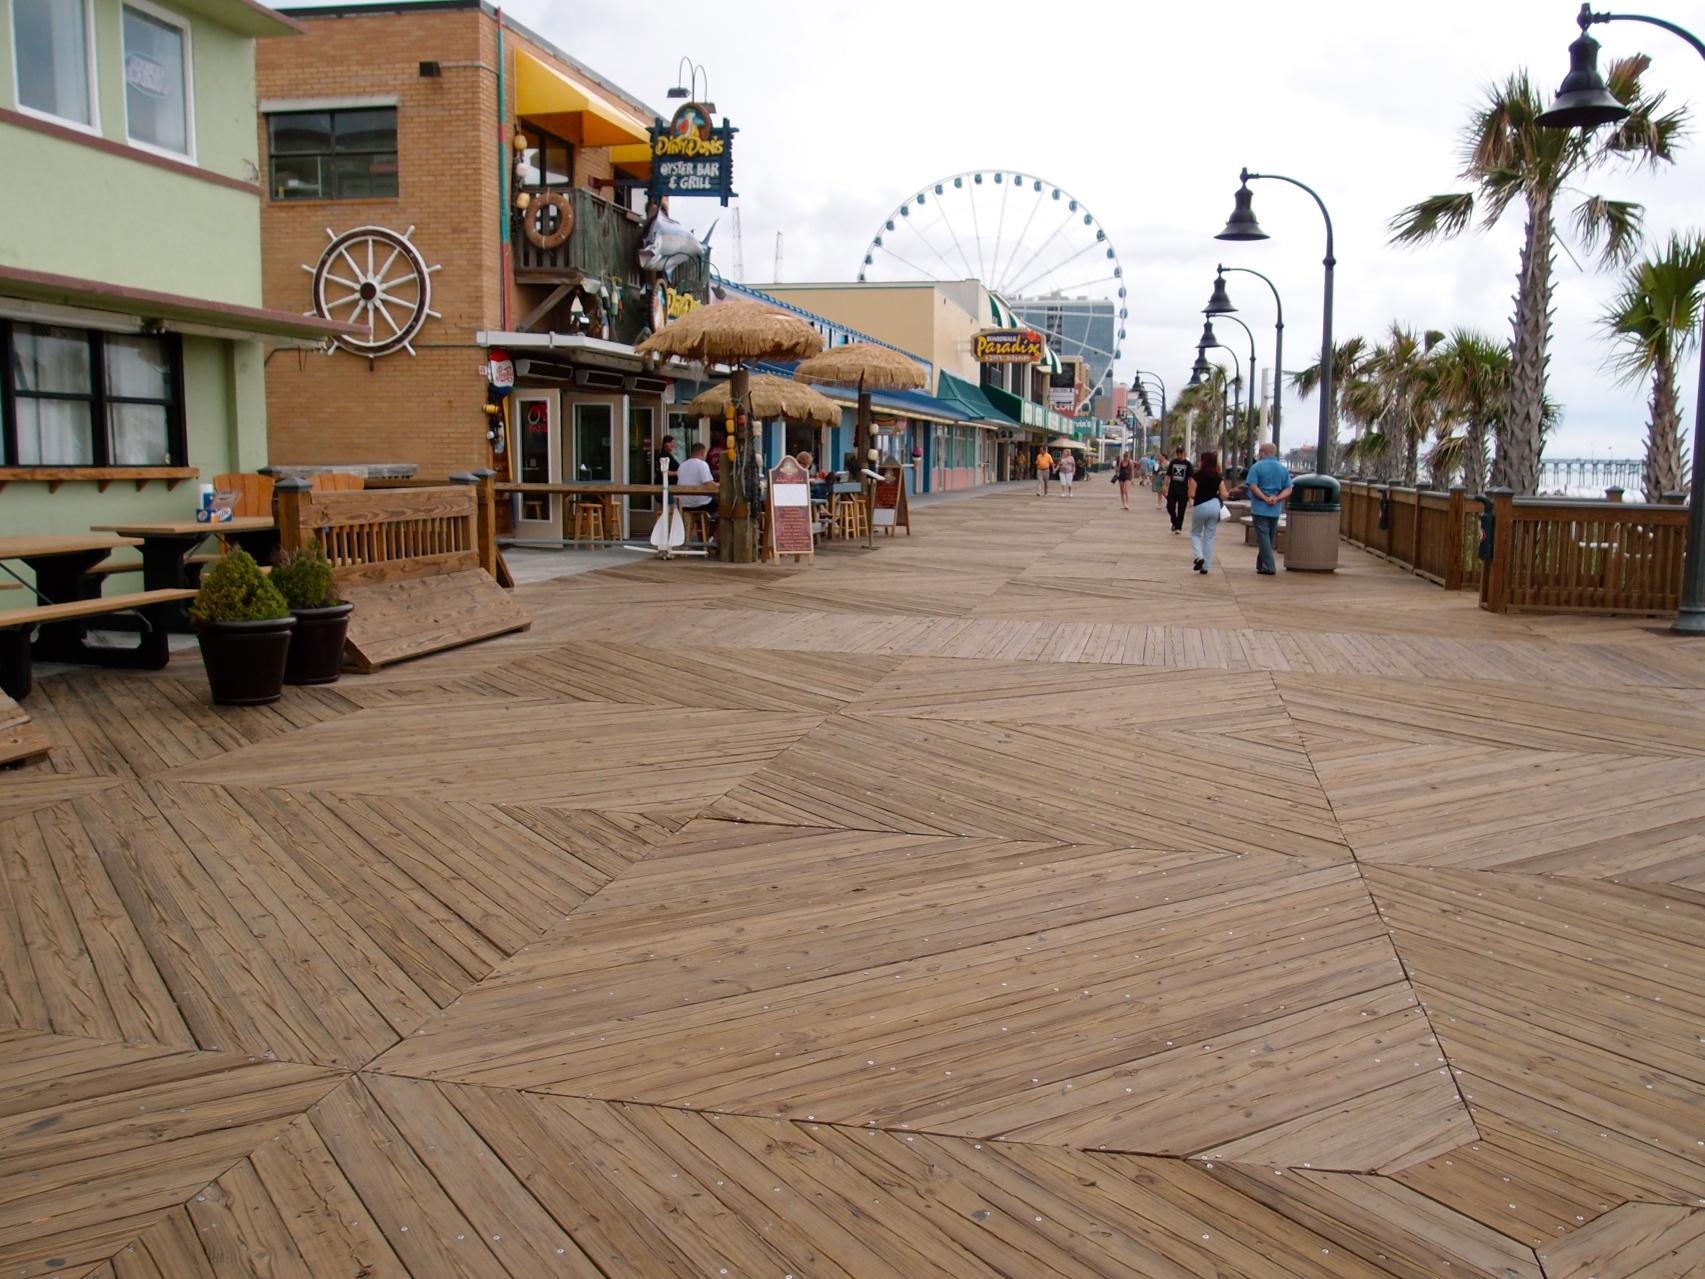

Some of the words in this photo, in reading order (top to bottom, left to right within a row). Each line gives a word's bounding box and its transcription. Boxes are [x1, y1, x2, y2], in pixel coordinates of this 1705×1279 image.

[660, 161, 693, 176] OYSTER
[696, 162, 720, 177] BAR
[680, 176, 711, 189] GRILL
